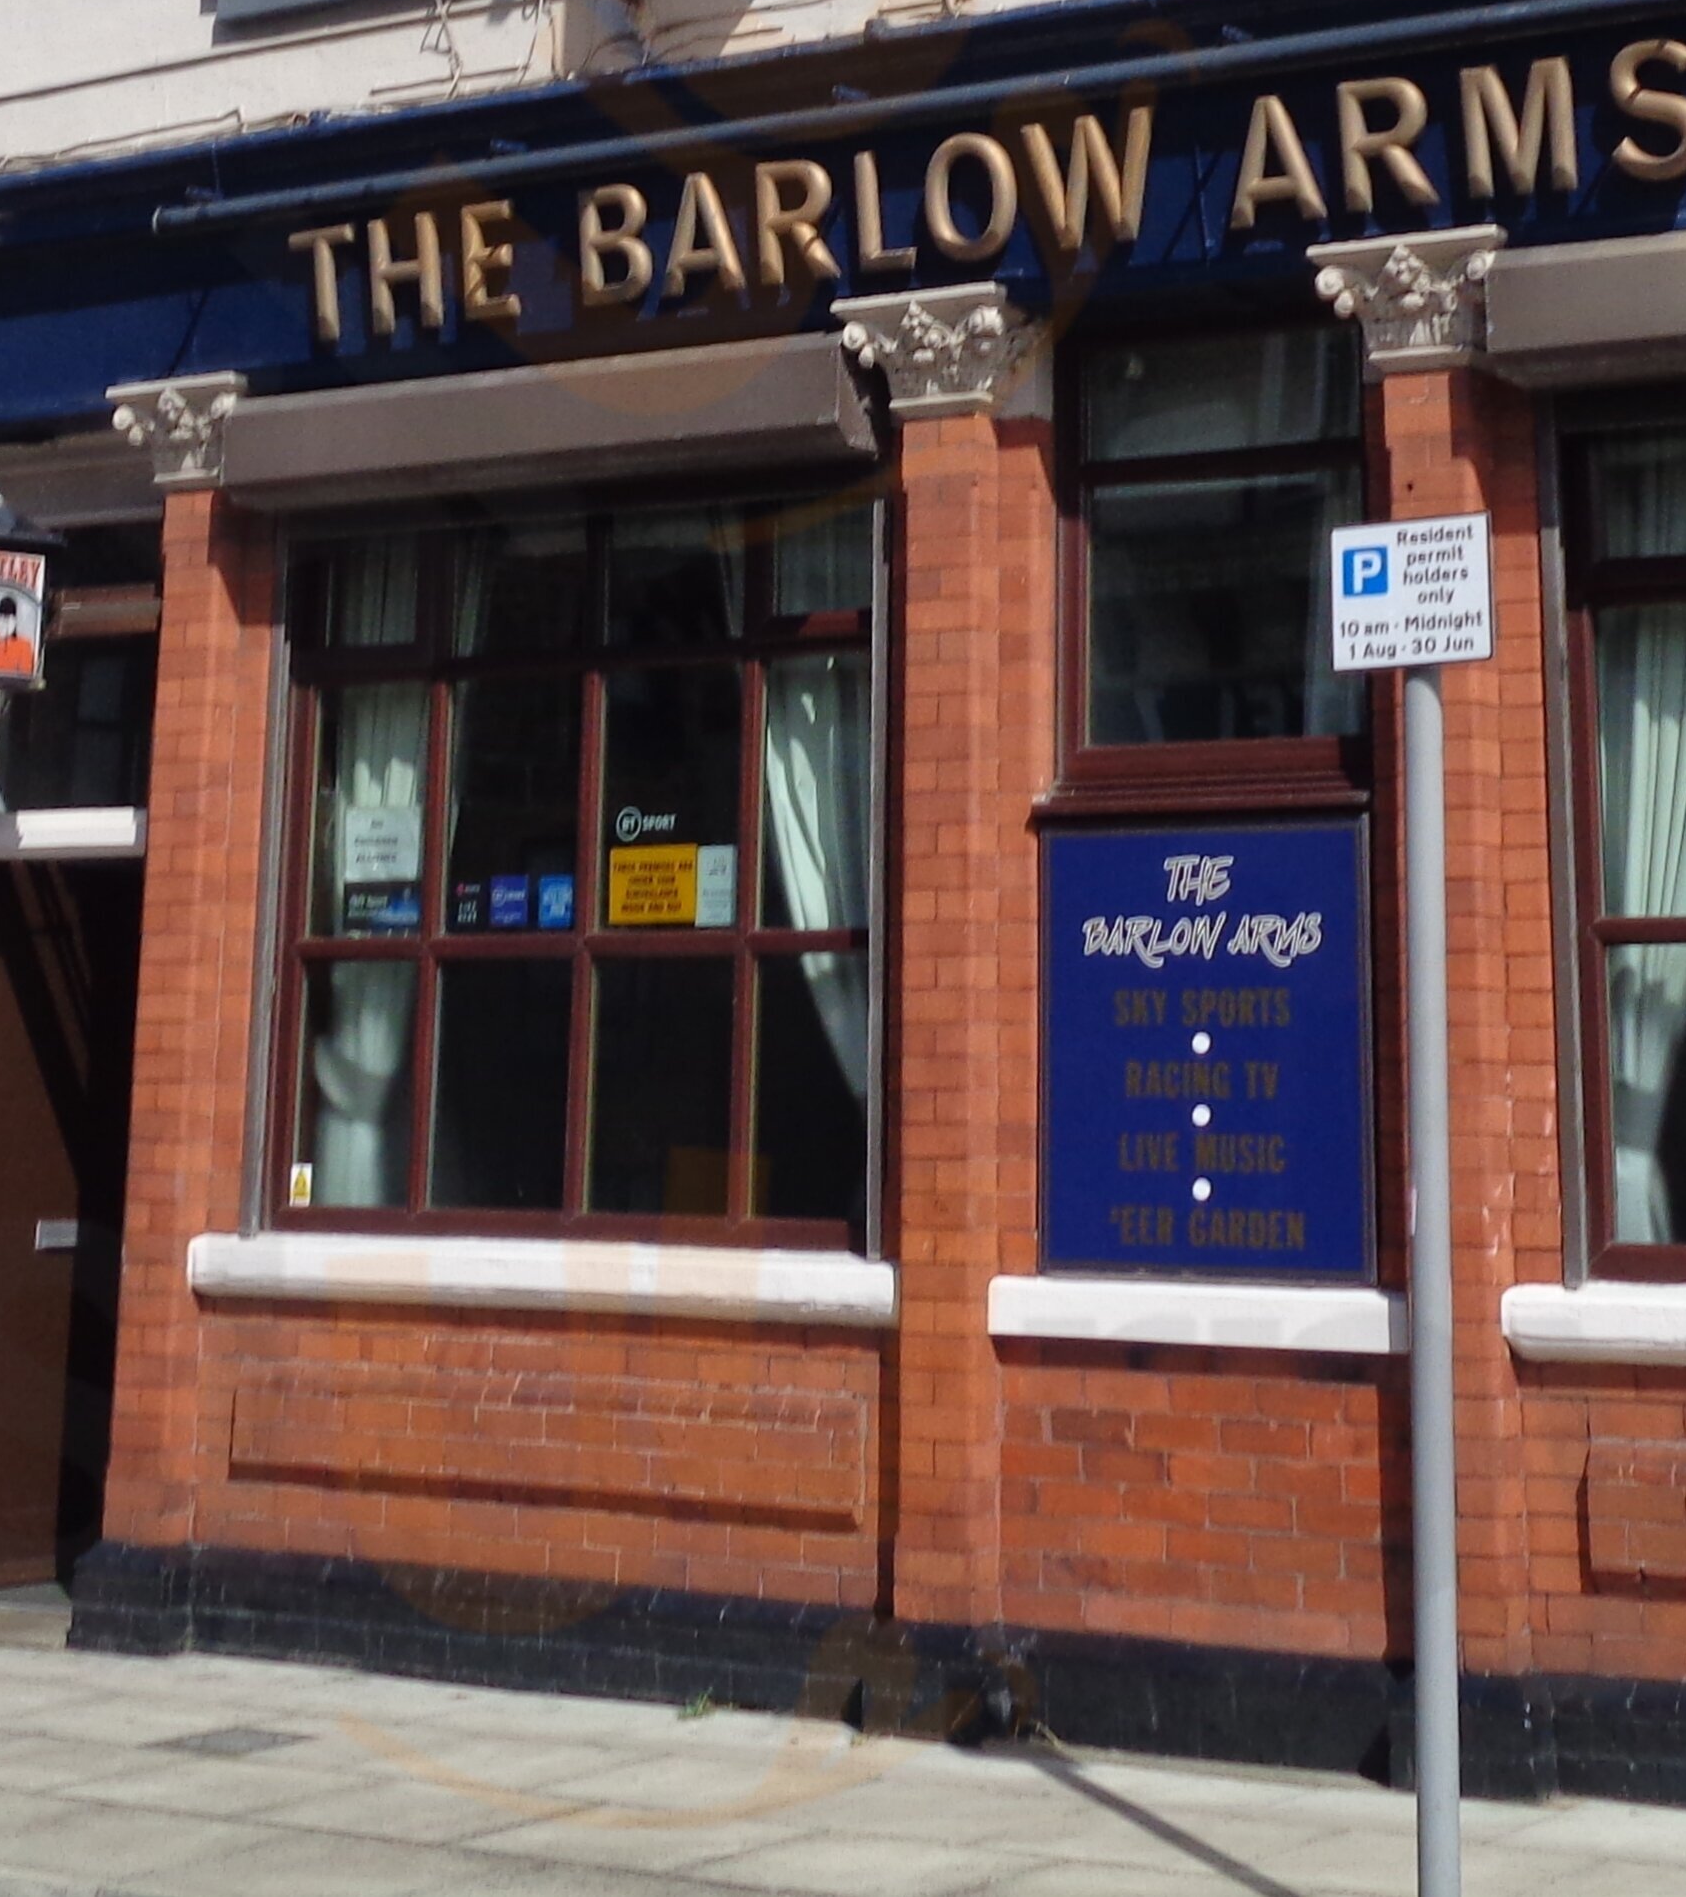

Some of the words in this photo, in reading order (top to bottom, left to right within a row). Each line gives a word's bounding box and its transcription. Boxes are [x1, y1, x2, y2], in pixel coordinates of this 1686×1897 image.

[287, 198, 522, 344] THE
[580, 105, 1158, 305] BARLOW
[1396, 524, 1473, 546] Resident
[1406, 546, 1464, 566] permit
[1403, 566, 1468, 586] holders
[1417, 586, 1454, 605] only
[1340, 620, 1359, 638] 10
[1404, 611, 1483, 636] Midnight
[1349, 643, 1356, 660] 1
[1362, 640, 1397, 662] Aug
[1413, 636, 1436, 655] 30
[1443, 635, 1474, 652] Jun
[642, 813, 677, 832] SPORT
[1163, 854, 1235, 906] THE
[1081, 910, 1228, 969] BARLOW
[1226, 910, 1323, 968] ARMS
[1114, 988, 1167, 1027] SKY
[1181, 987, 1291, 1028] SPORTS
[1125, 1060, 1231, 1099] RACING
[1244, 1061, 1278, 1100] TV
[1118, 1132, 1180, 1172] LIVE
[1194, 1133, 1287, 1174] MUSIC
[1111, 1205, 1175, 1246] EER
[1187, 1207, 1306, 1252] GARDEN
